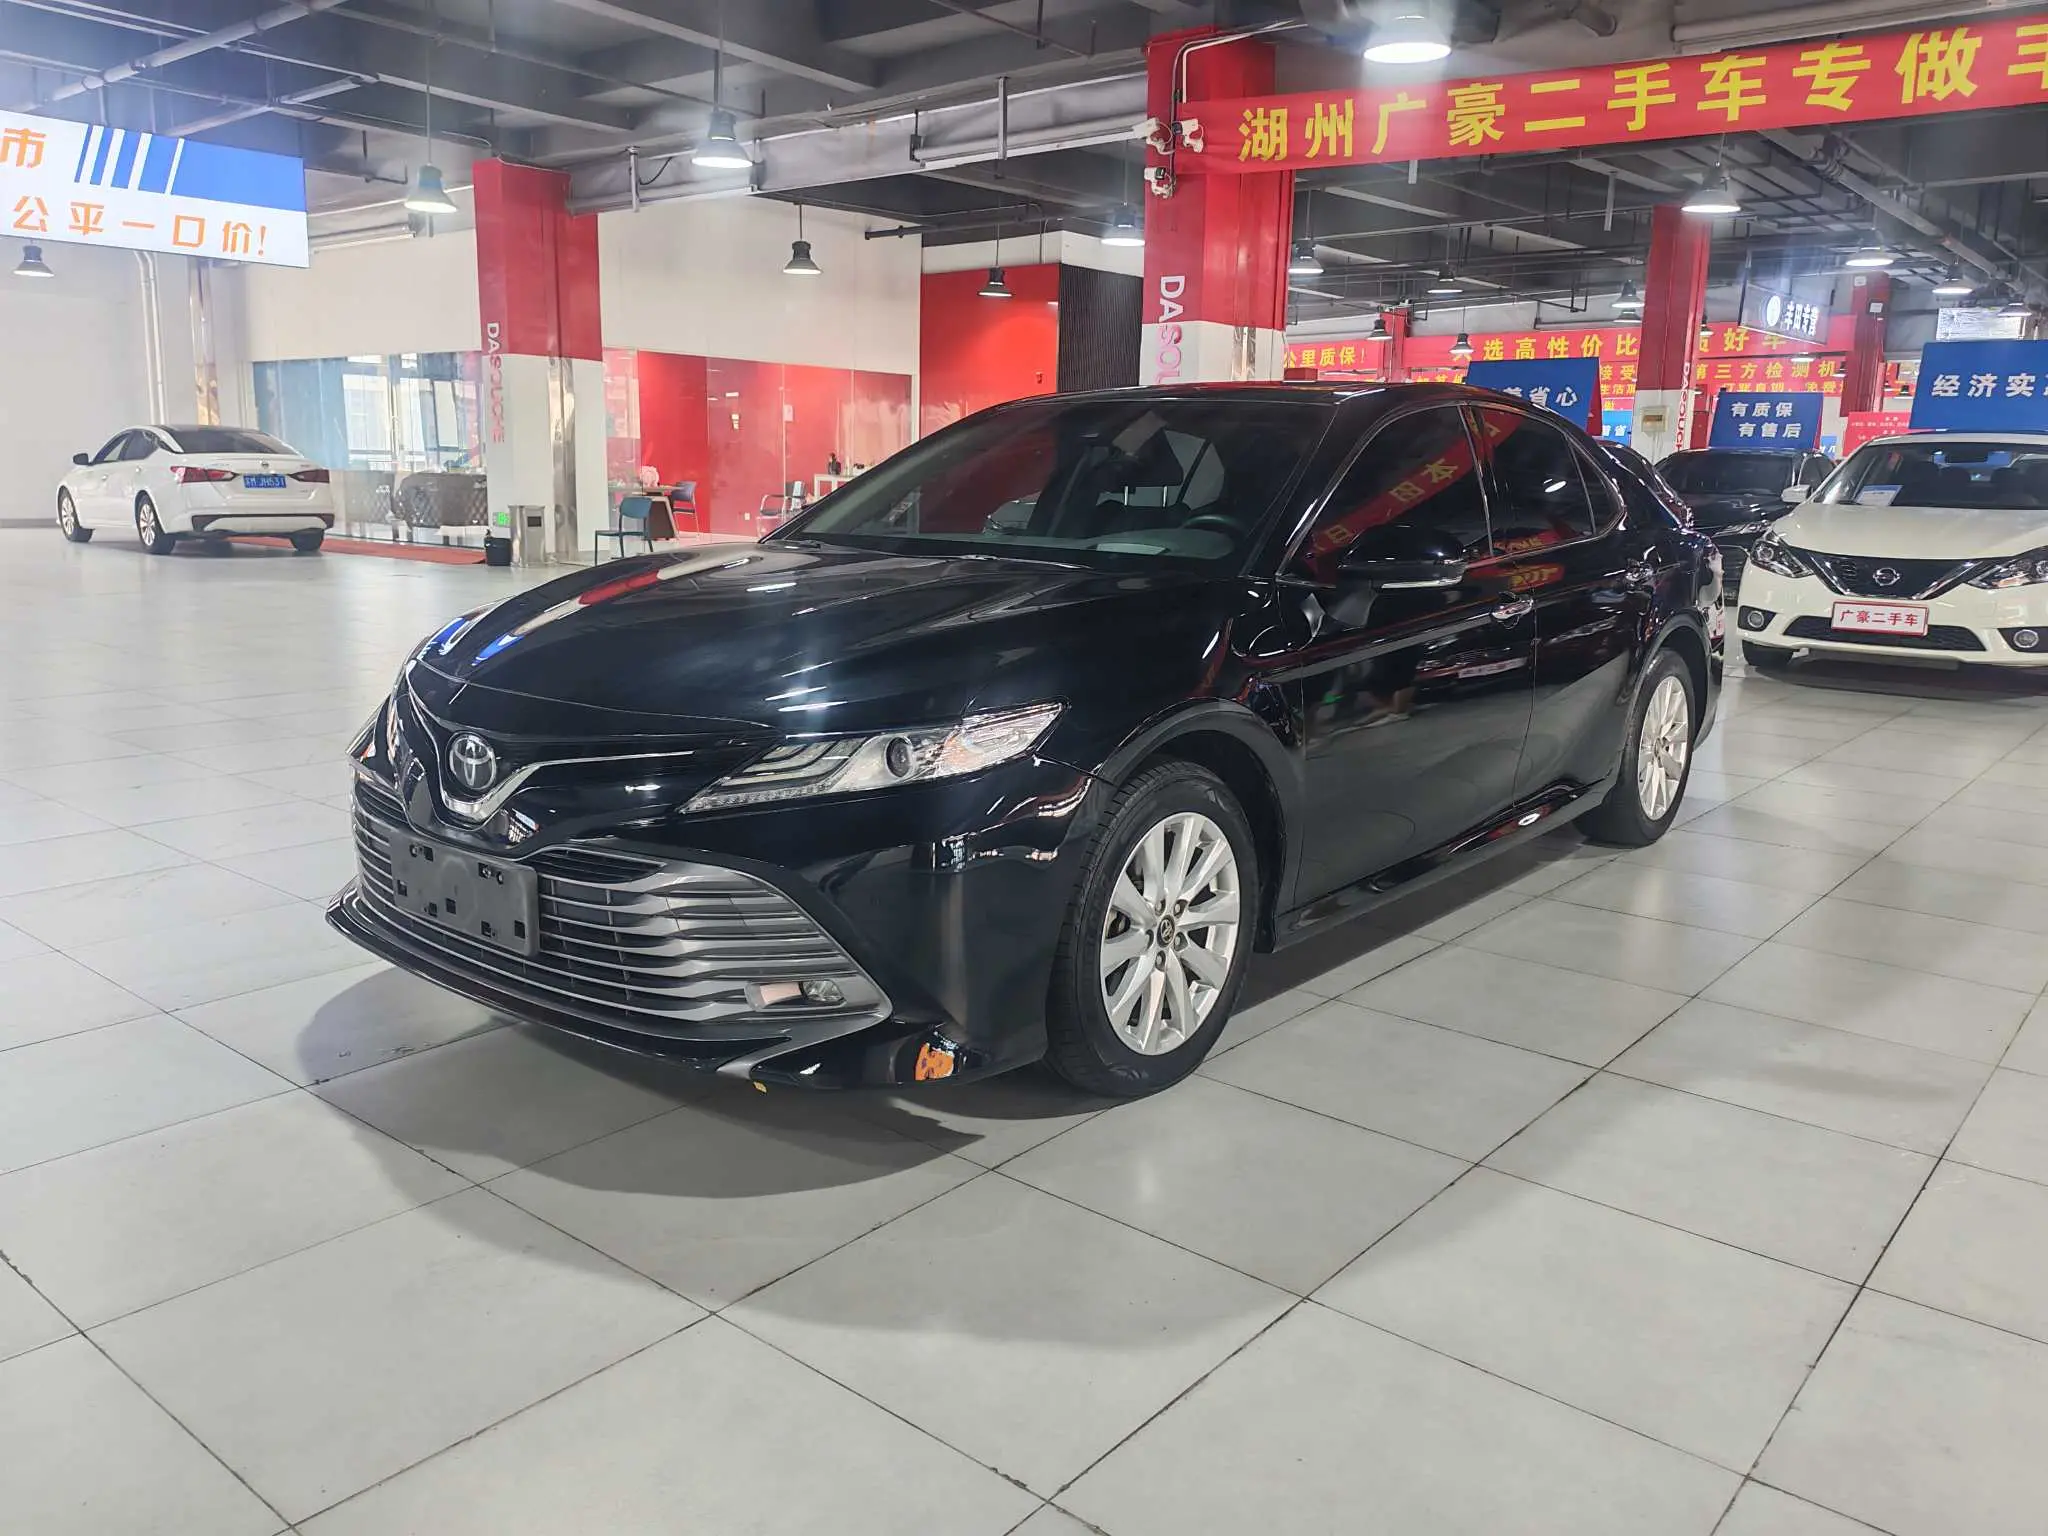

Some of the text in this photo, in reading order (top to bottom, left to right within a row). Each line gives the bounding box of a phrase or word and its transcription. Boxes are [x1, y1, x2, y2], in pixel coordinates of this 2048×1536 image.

[0, 127, 47, 168] 市
[13, 195, 267, 256] 公平一口价!
[1931, 372, 2048, 398] 经济实
[1731, 401, 1794, 418] 有质保
[1738, 422, 1802, 439] 有售后
[1839, 609, 1919, 627] 广豪二手车
